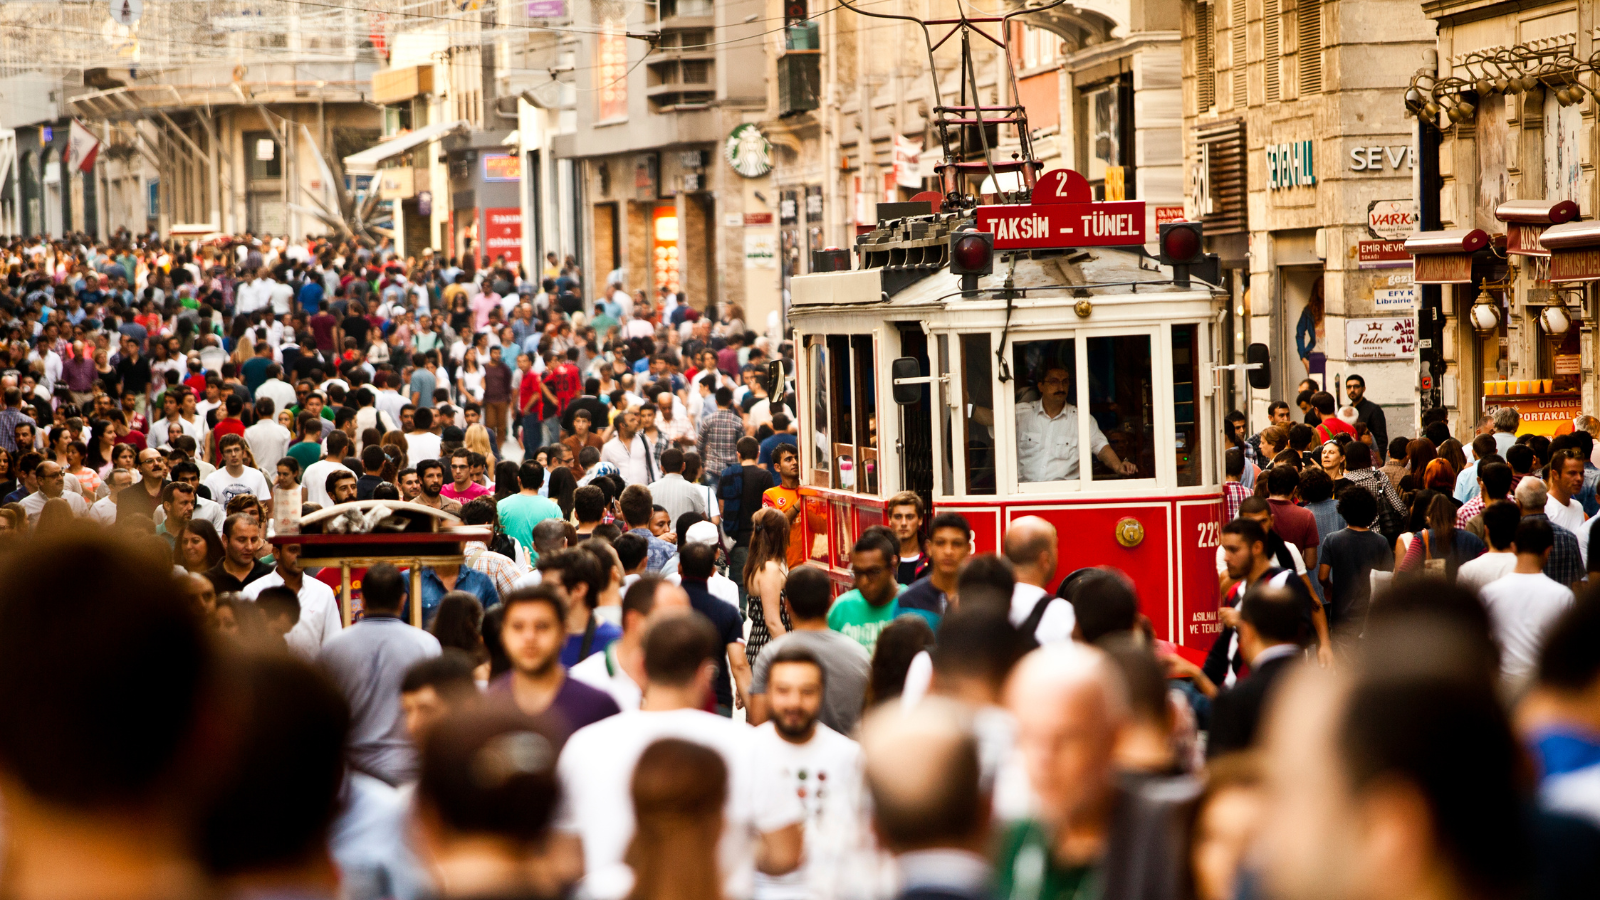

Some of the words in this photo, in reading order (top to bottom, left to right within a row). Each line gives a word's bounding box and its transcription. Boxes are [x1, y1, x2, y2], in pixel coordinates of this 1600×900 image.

[1056, 172, 1068, 197] 2
[1371, 213, 1414, 225] VARK
[987, 212, 1049, 240] TAKSİM
[1081, 211, 1140, 237] TÜNEL
[1520, 225, 1548, 251] KOSK
[1361, 243, 1380, 253] EMİR
[1382, 243, 1405, 253] NEVR
[1538, 399, 1582, 409] ORANGE
[1519, 411, 1572, 422] PORTAKAL
[1197, 521, 1220, 548] 223
[1189, 624, 1199, 634] VE
